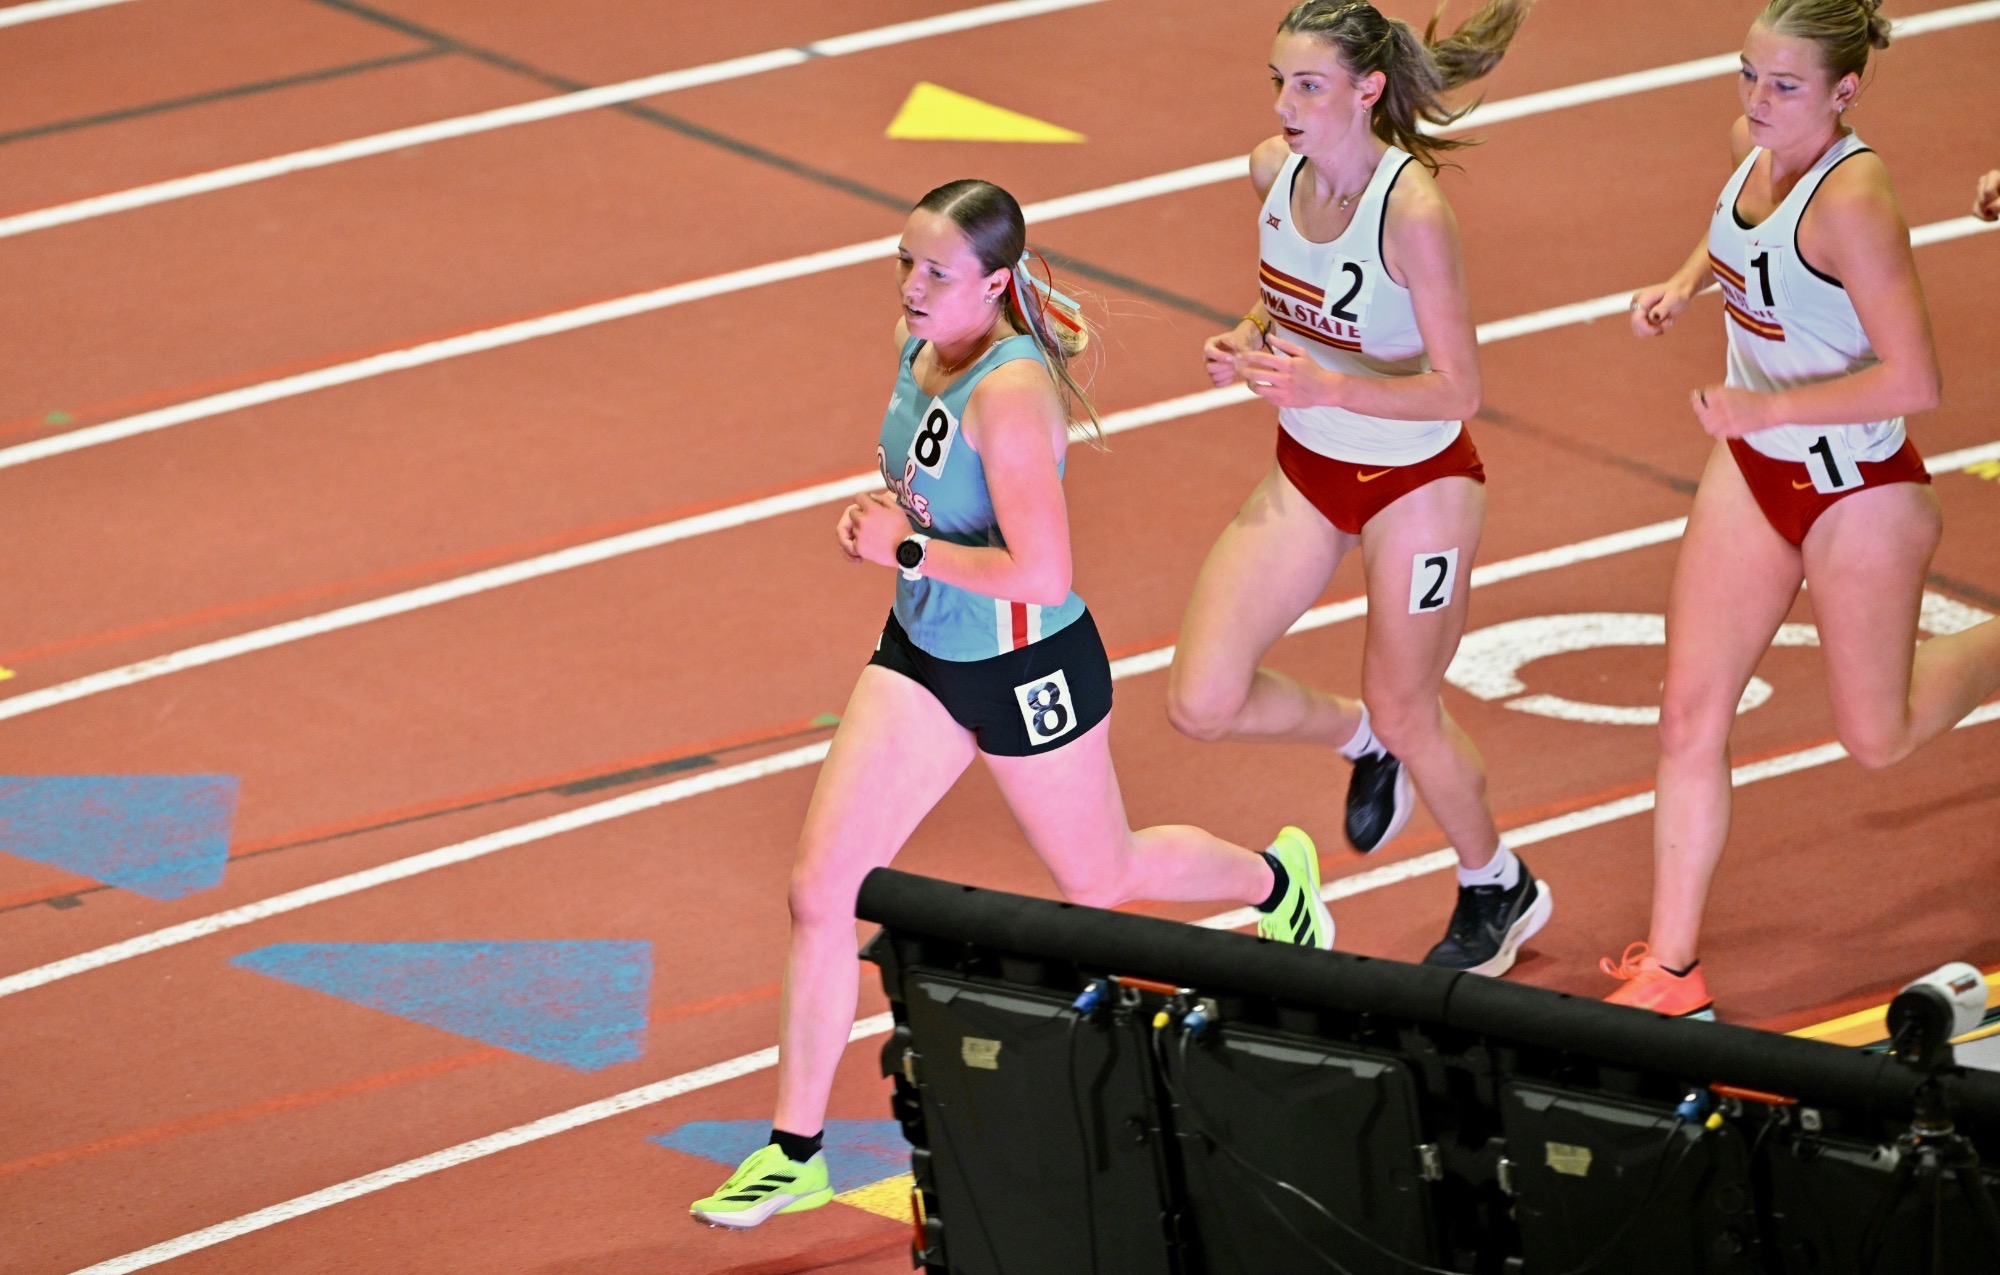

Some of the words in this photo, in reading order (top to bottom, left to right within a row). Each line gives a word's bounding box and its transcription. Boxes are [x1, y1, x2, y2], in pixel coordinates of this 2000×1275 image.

[1260, 287, 1292, 318] OWA
[1331, 261, 1363, 323] 2
[1750, 251, 1775, 307] 1
[914, 407, 949, 468] 8
[1808, 435, 1845, 488] 1
[1419, 555, 1449, 610] 2
[1026, 681, 1068, 737] 8
